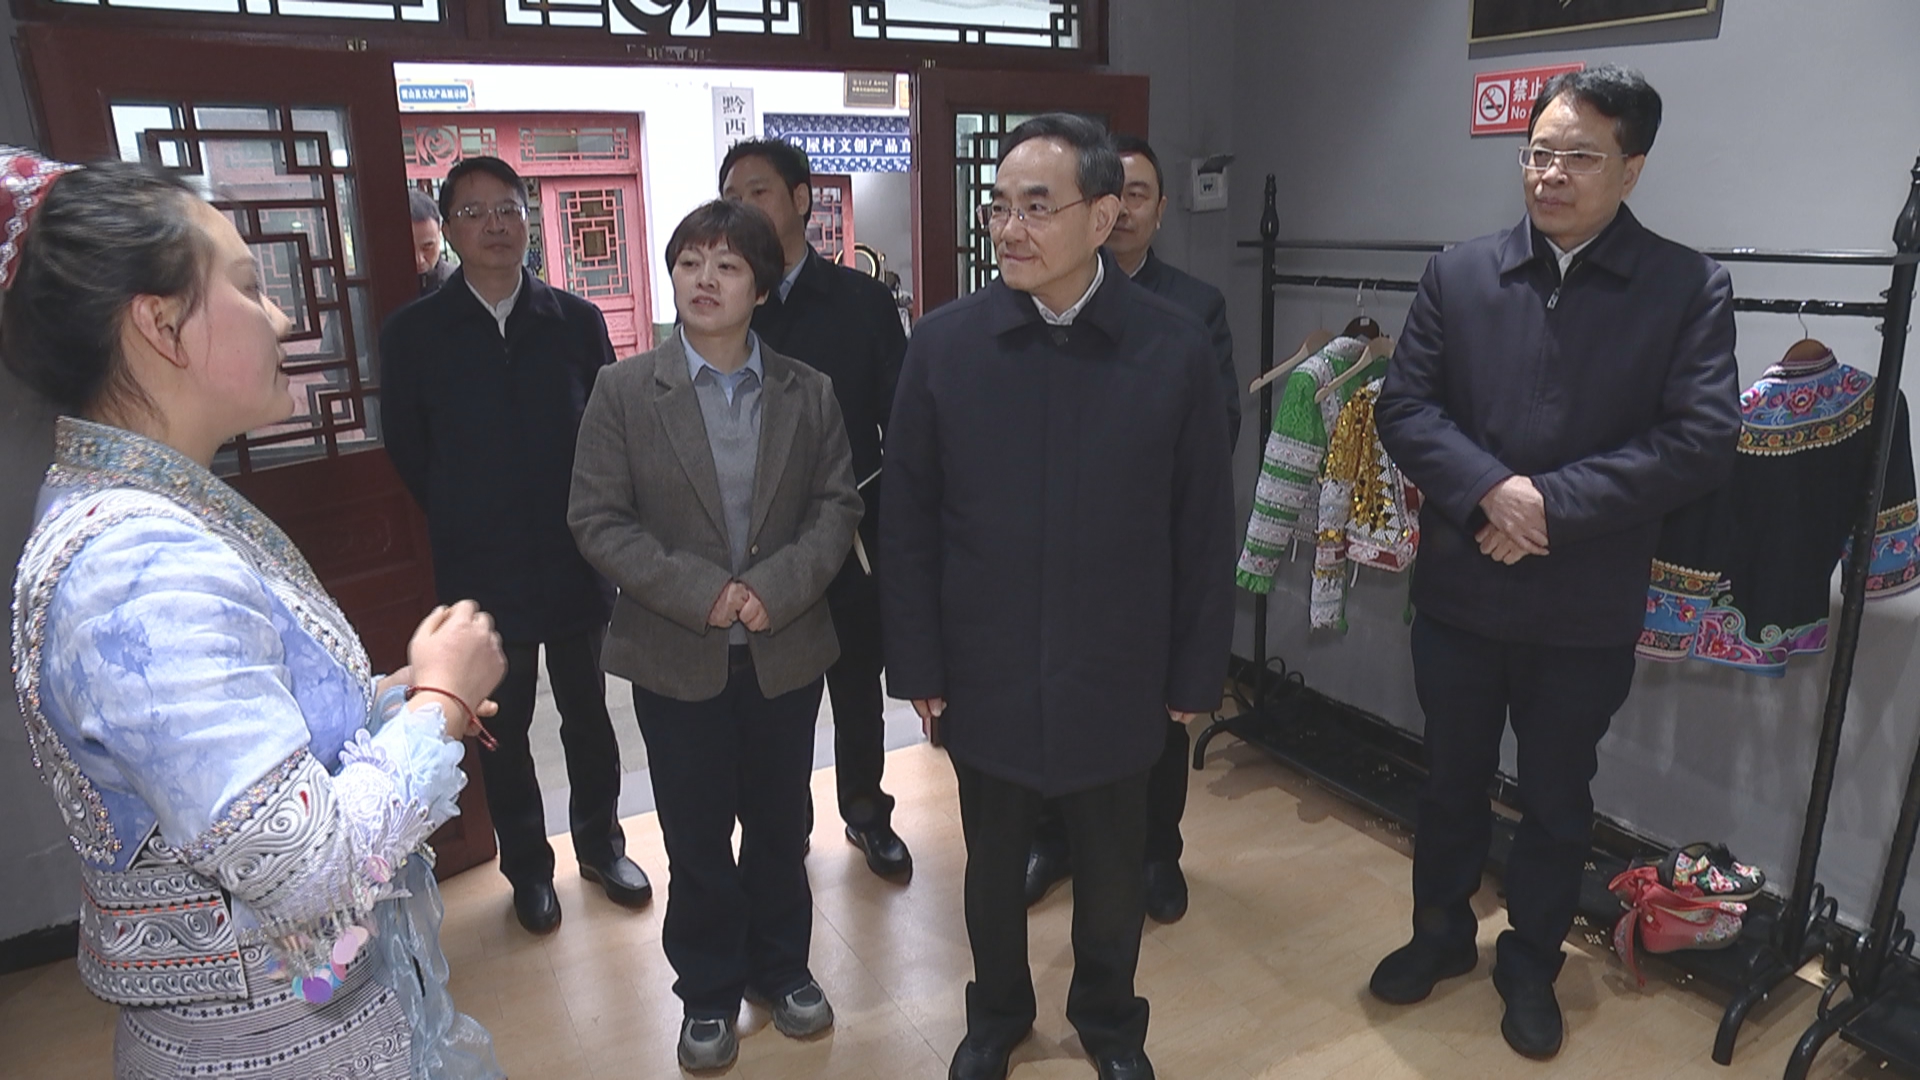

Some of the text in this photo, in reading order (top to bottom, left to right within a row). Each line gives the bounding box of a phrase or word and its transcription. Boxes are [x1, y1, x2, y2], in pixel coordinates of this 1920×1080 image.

[1512, 76, 1543, 103] 禁止
[722, 95, 746, 146] 黔西
[1511, 106, 1527, 119] No
